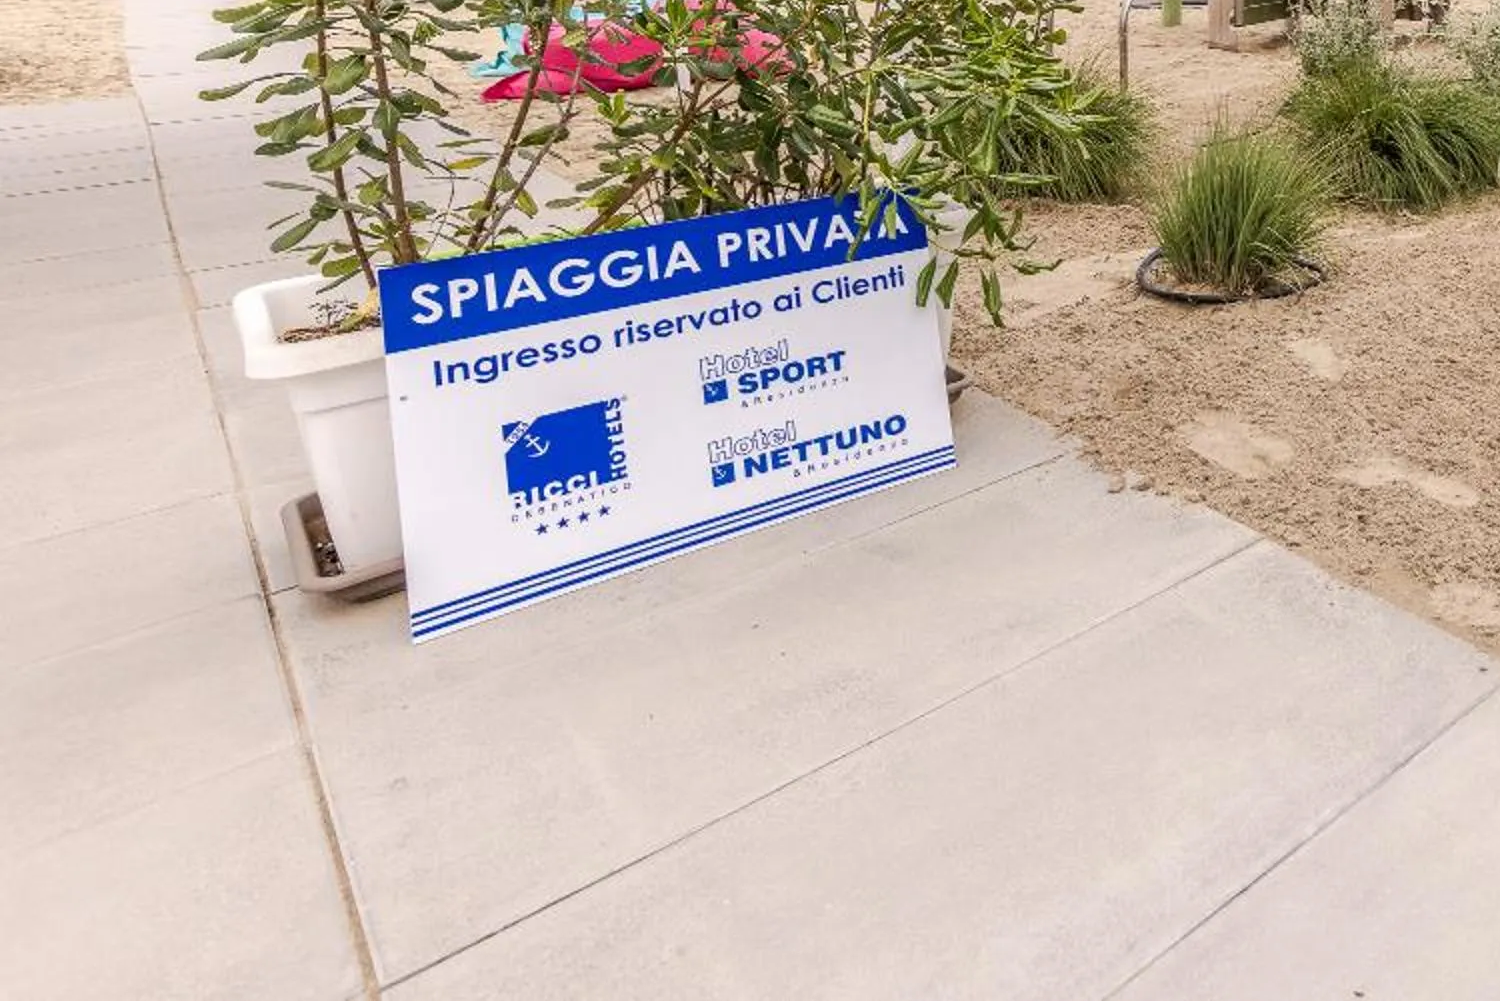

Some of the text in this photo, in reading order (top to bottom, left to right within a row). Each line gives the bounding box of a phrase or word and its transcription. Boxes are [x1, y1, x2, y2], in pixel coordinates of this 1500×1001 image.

[411, 240, 701, 324] SPIAGGIA
[433, 265, 905, 386] Ingresso riservato ai Clienti
[699, 338, 789, 380] Hotel
[738, 351, 846, 394] SPORT
[606, 398, 628, 480] HOTELS
[708, 420, 797, 463] Hotel
[744, 414, 907, 477] NETTUNO
[508, 471, 598, 508] RICCI
